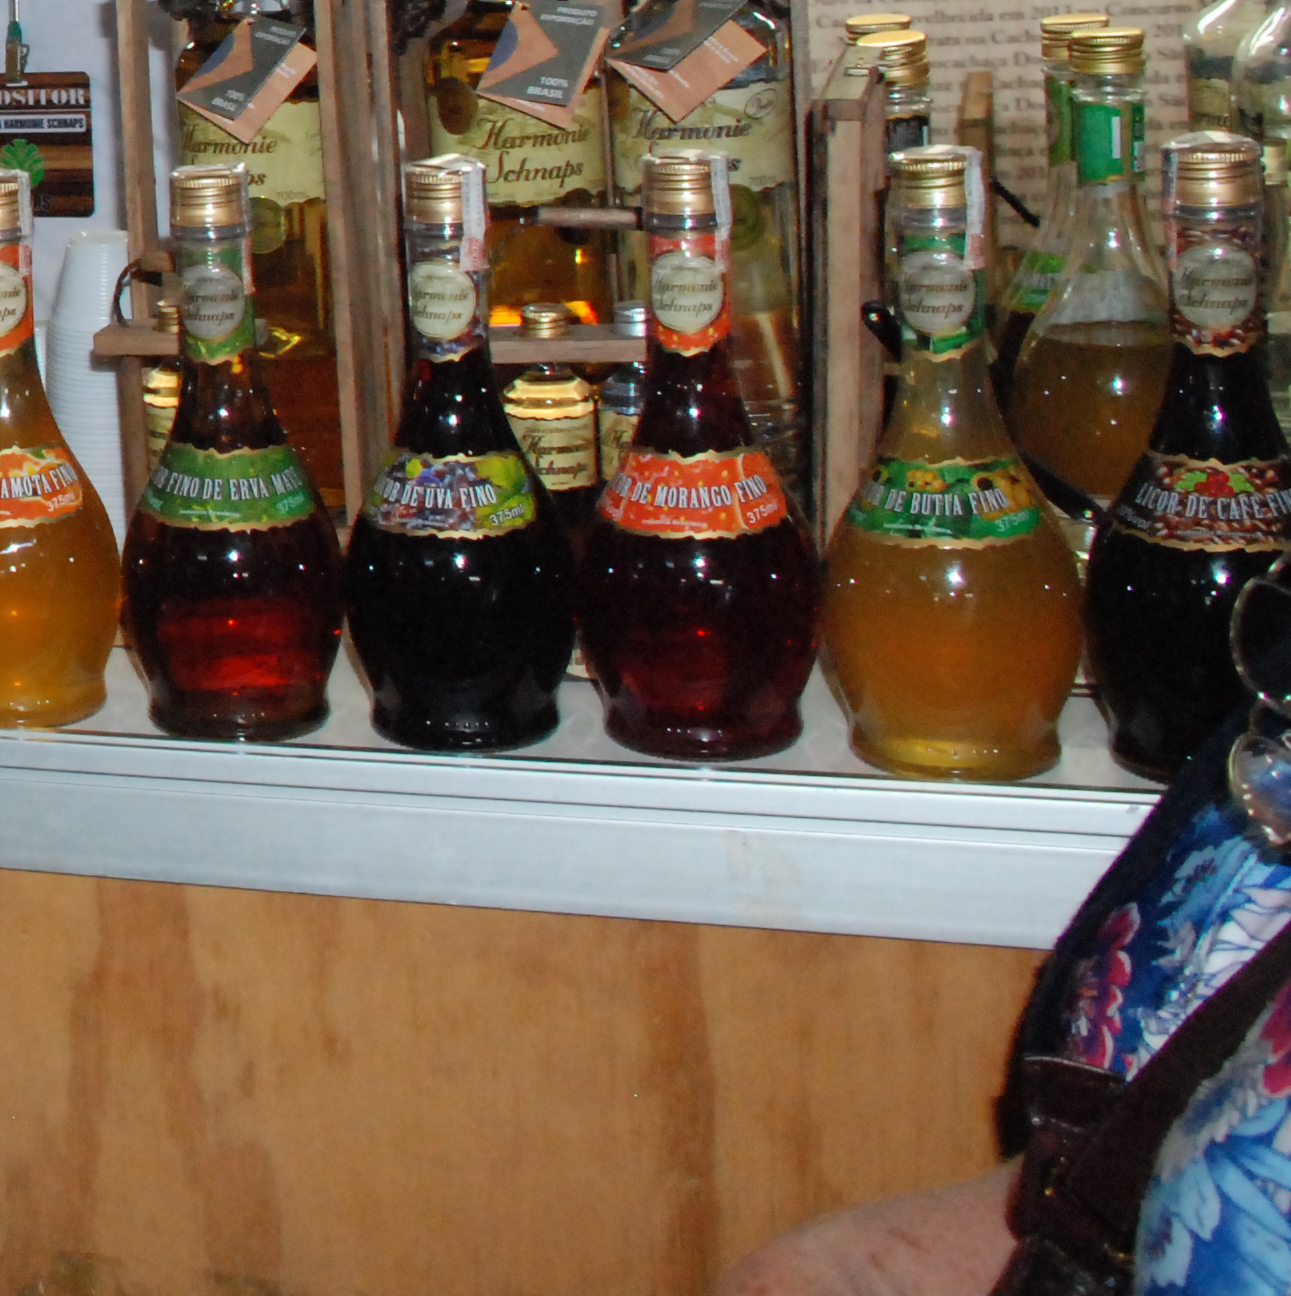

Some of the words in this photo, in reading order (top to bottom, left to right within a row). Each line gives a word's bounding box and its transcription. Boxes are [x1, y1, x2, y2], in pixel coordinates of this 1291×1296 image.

[168, 472, 200, 499] FINO
[203, 478, 223, 500] DE
[229, 477, 269, 501] ERVA
[401, 484, 418, 507] DE
[424, 488, 453, 509] UVA
[459, 483, 497, 509] FINO
[631, 480, 653, 505] DE
[653, 484, 732, 509] MORANGO
[733, 474, 768, 504] FINO
[1135, 482, 1179, 515] LICOR
[1185, 494, 1209, 519] DE
[489, 503, 525, 527] 375ml
[884, 488, 907, 513] DE
[967, 488, 1009, 515] FINO
